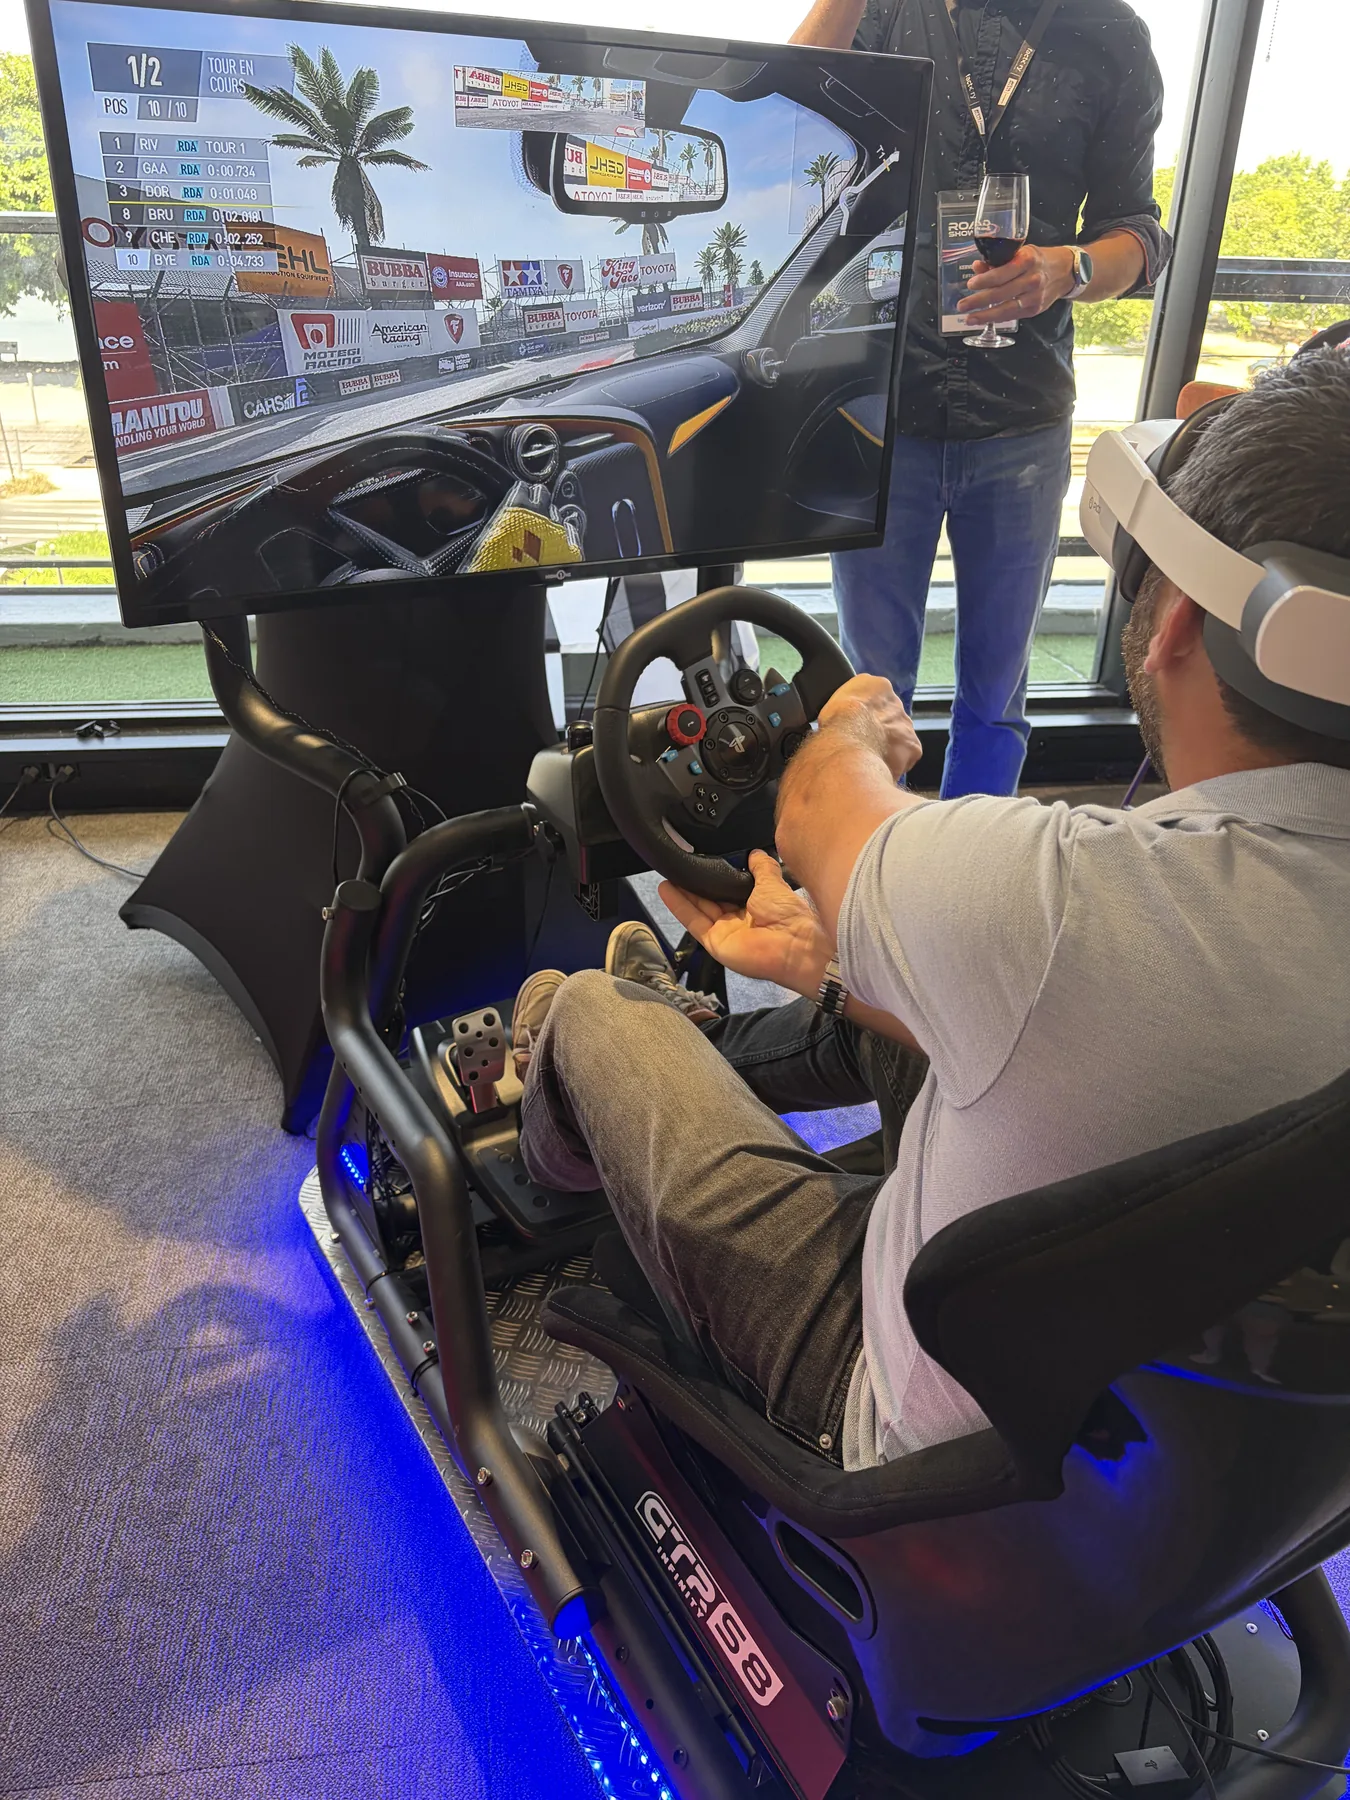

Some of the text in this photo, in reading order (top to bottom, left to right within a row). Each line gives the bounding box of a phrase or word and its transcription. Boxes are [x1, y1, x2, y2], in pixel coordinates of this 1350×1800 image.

[127, 53, 162, 88] 1/2
[208, 57, 254, 76] TOUR EN
[210, 76, 247, 94] COURS
[104, 97, 128, 114] POS
[148, 99, 161, 117] 10
[114, 137, 246, 155] 1 RIV RDA TOUR 1
[116, 162, 256, 178] 2 GAA RDA 0:00.734
[120, 185, 128, 198] 3
[183, 187, 203, 199] RDA
[210, 187, 258, 200] 0:01.048
[122, 207, 131, 220] 8
[148, 208, 174, 221] BRU
[185, 210, 205, 221] RDA
[125, 231, 133, 243] 9
[151, 231, 176, 243] CHE
[188, 232, 208, 244] RDA
[127, 253, 264, 267] 10 BYE RDA 0:04.733
[366, 261, 423, 278] BUBBA
[448, 269, 479, 279] Insurance
[602, 258, 635, 277] King
[640, 264, 675, 275] TOYOTA
[371, 280, 424, 290] burger
[610, 271, 638, 289] Taco
[505, 286, 544, 297] TAMIYA
[637, 301, 666, 312] verizon
[526, 311, 560, 323] BUBBA
[565, 310, 598, 322] TOYOTA
[371, 322, 427, 334] American
[381, 332, 421, 346] Racing
[303, 348, 361, 361] MOTEGI
[305, 356, 362, 370] RACING
[243, 395, 284, 419] CARS
[154, 424, 178, 438] YOUR
[177, 418, 205, 432] WORLD
[657, 1546, 704, 1619] INFINITY
